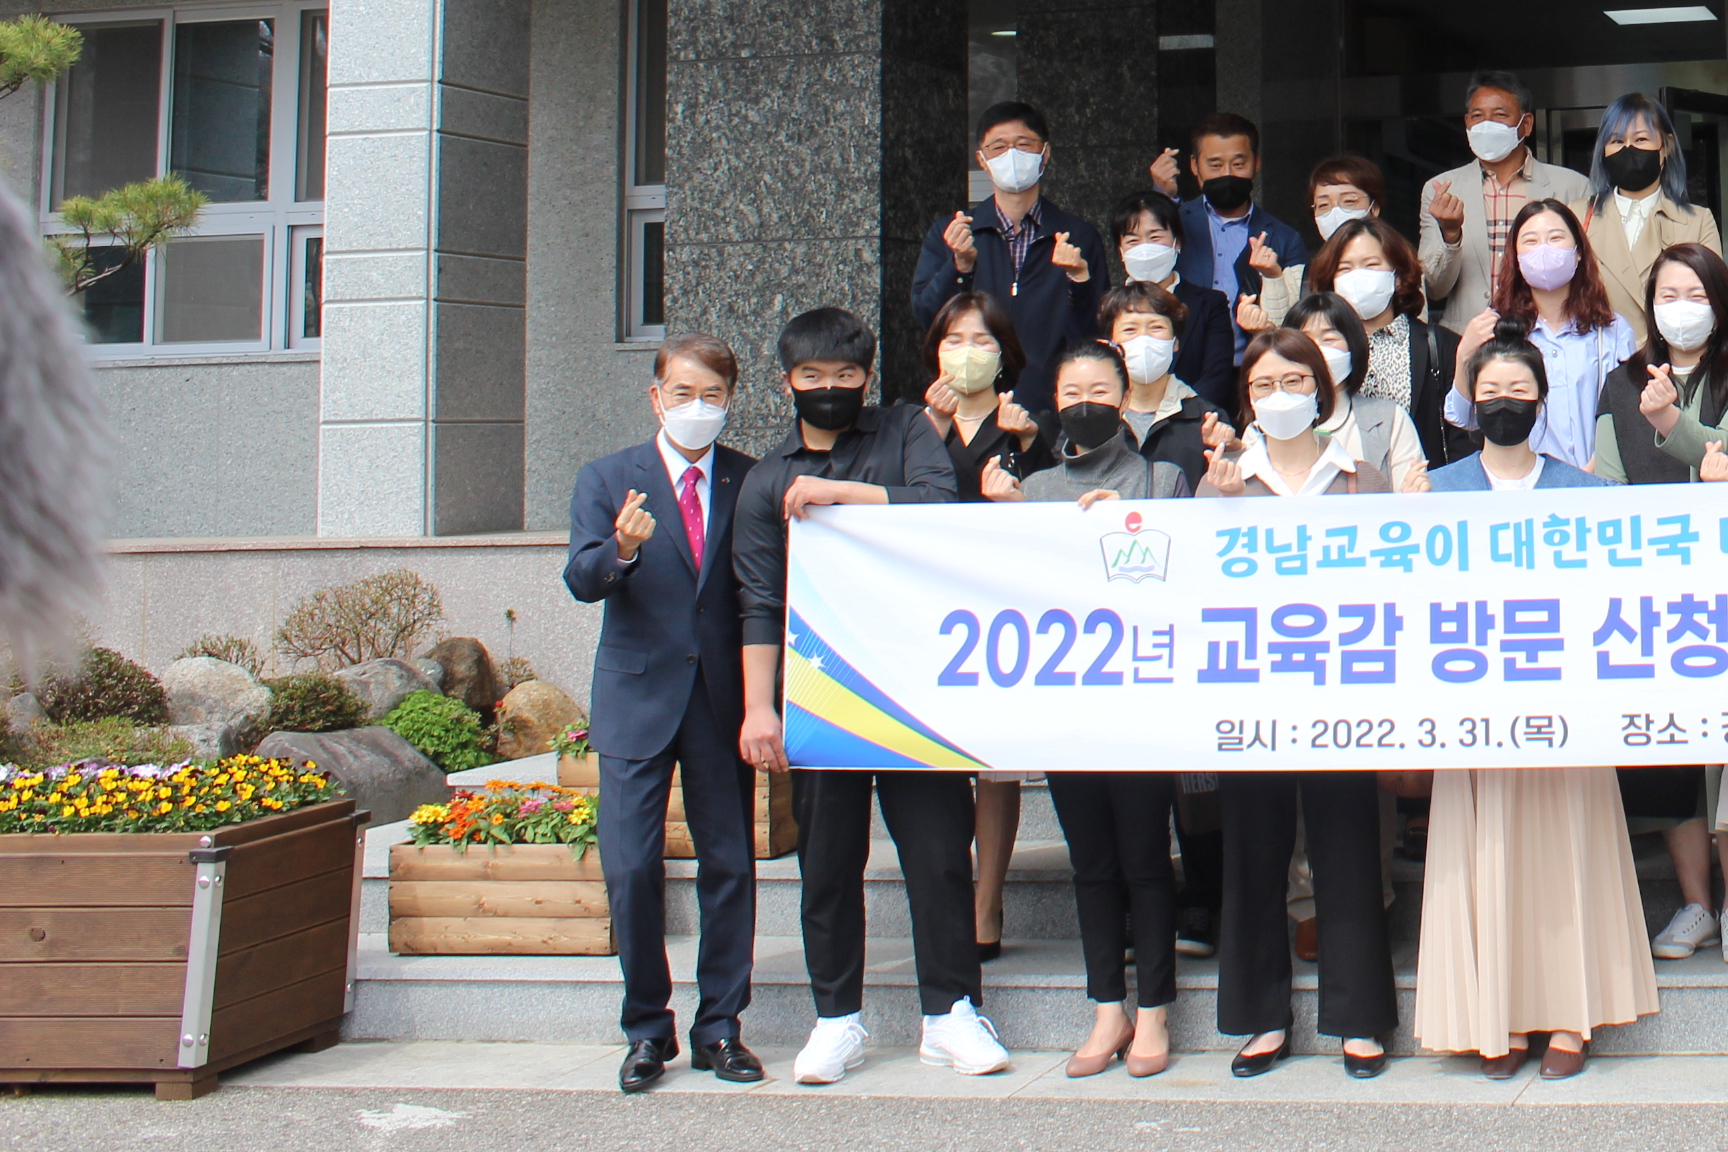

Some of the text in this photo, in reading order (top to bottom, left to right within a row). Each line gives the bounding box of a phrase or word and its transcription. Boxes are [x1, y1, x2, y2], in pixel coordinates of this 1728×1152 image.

[1215, 519, 1470, 578] 경남교육이
[1489, 512, 1700, 571] 대한민국
[936, 608, 1175, 689] 2022년
[1196, 602, 1404, 687] 교육감
[1429, 599, 1565, 685] 방문
